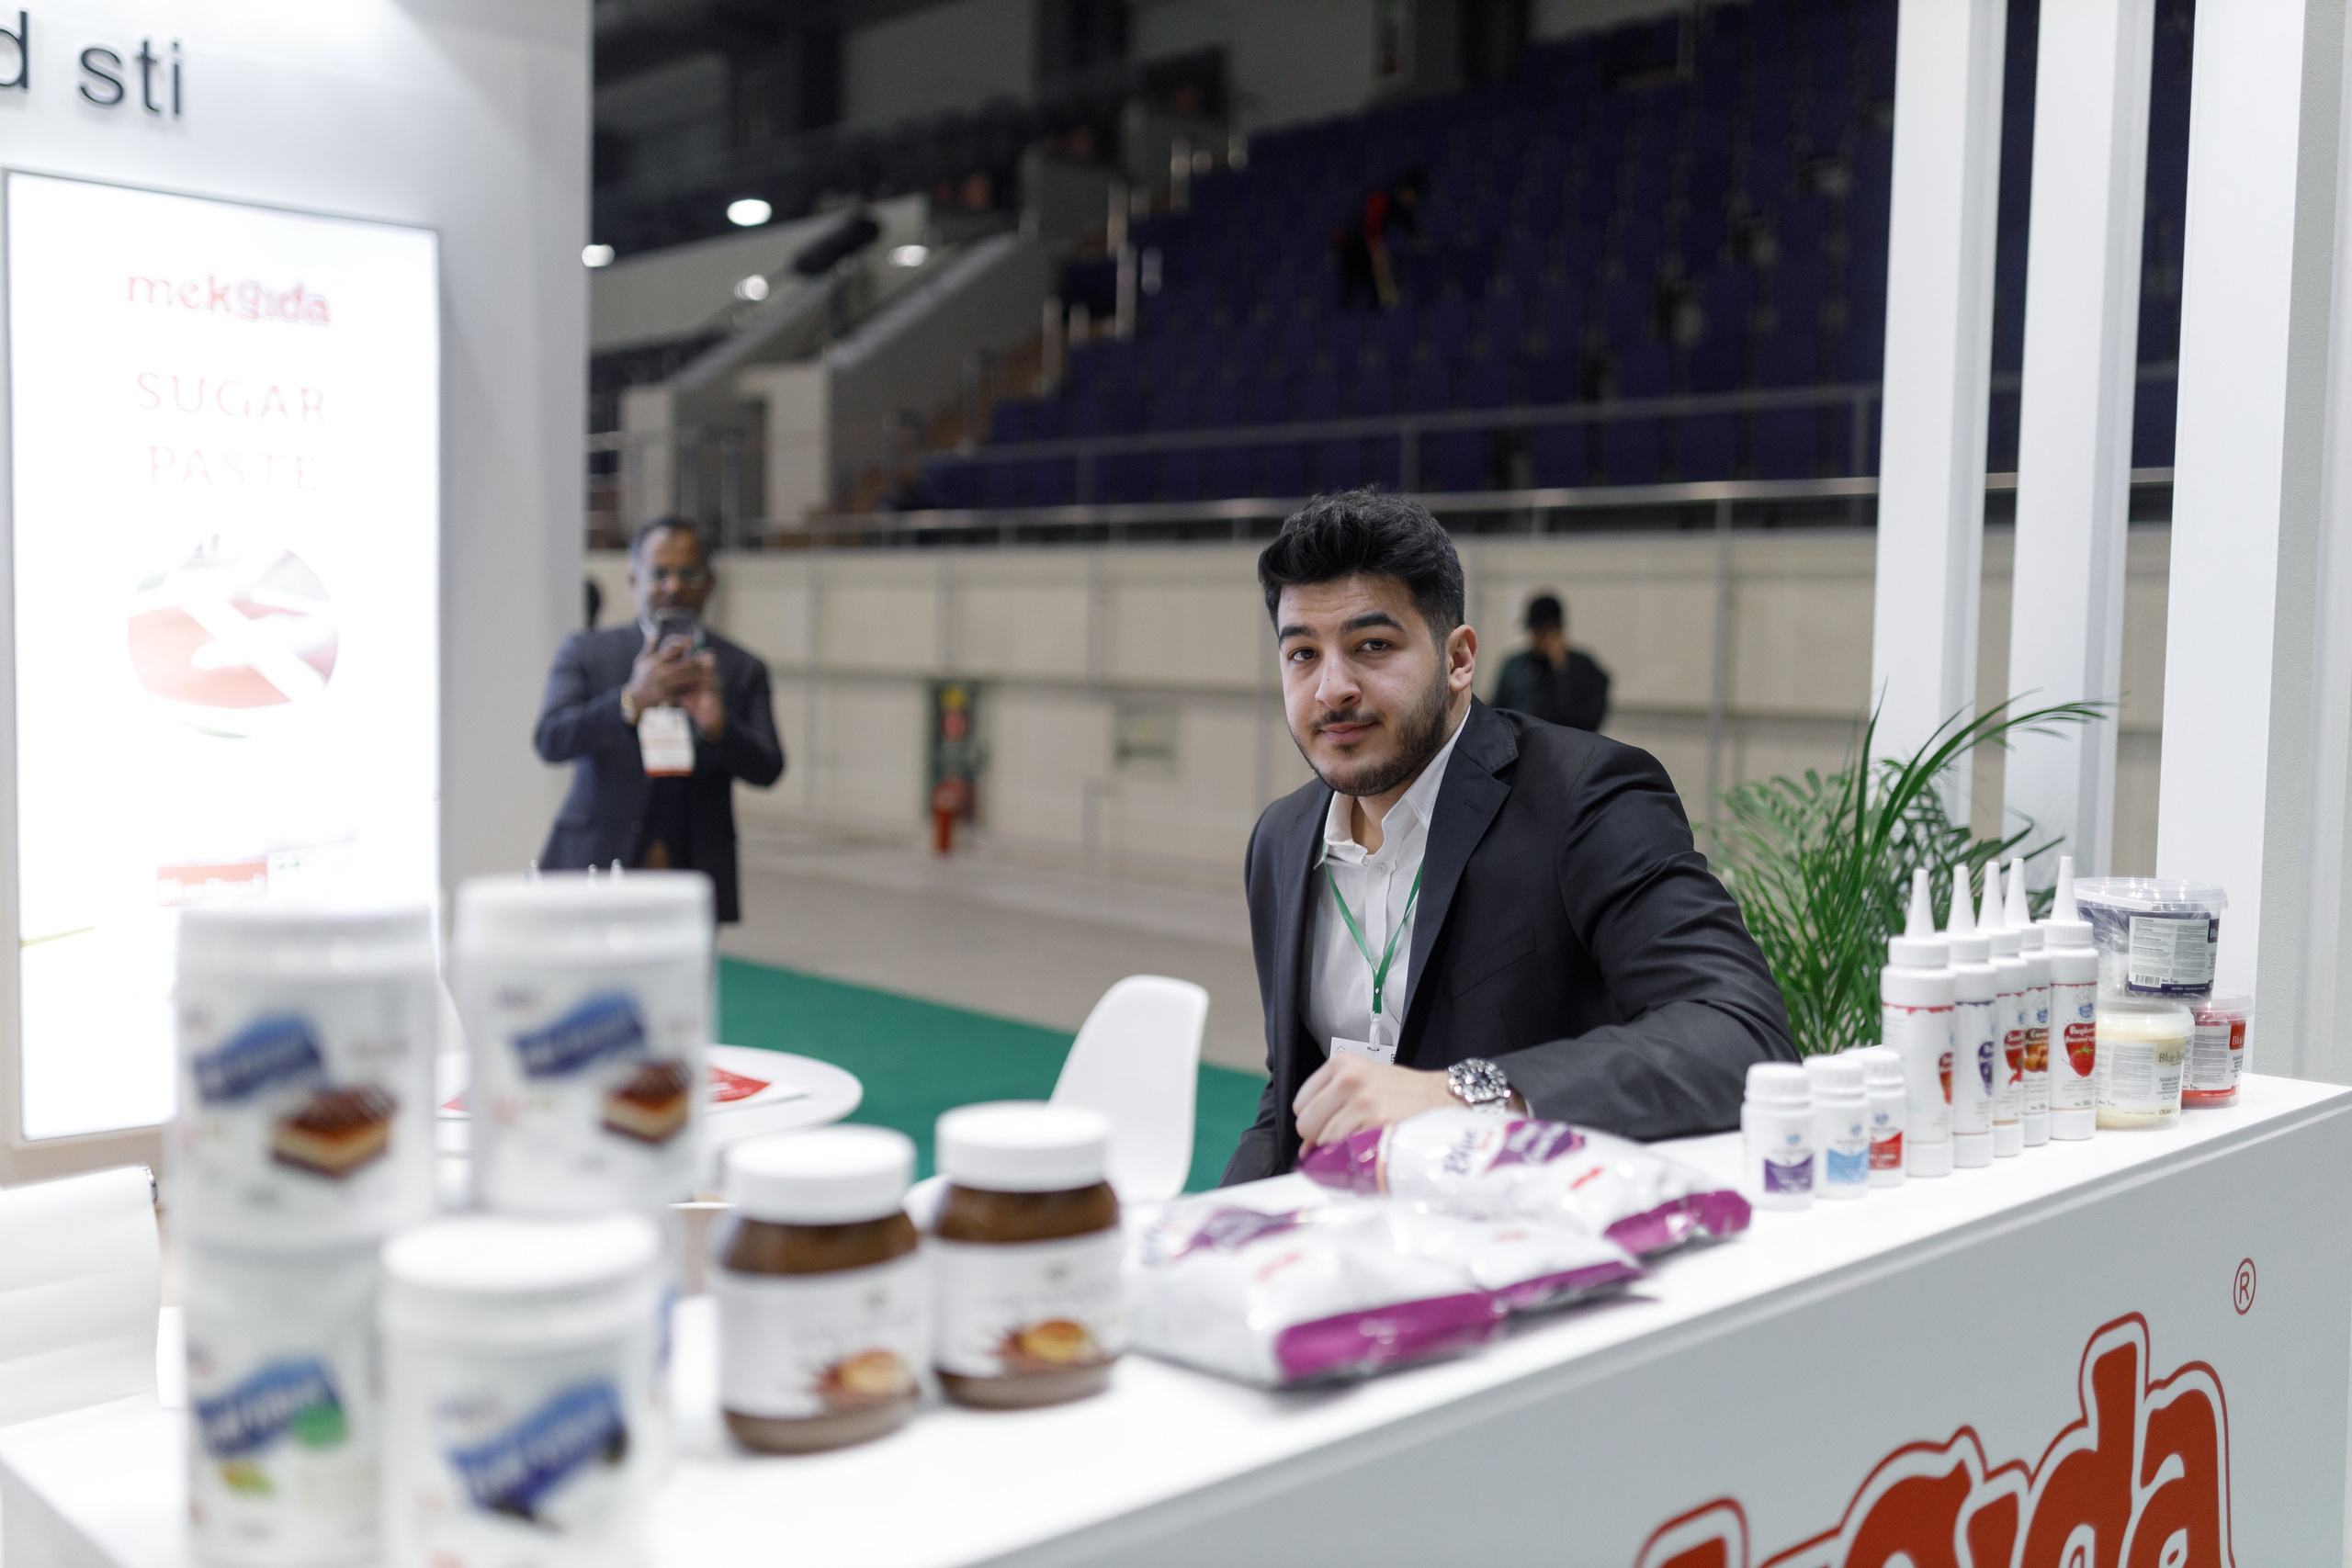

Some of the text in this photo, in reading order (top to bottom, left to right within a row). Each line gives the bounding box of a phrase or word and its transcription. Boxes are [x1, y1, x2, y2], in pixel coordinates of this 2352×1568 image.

[78, 39, 183, 118] sti
[136, 371, 326, 422] SUGAR
[148, 445, 318, 491] PASTE
